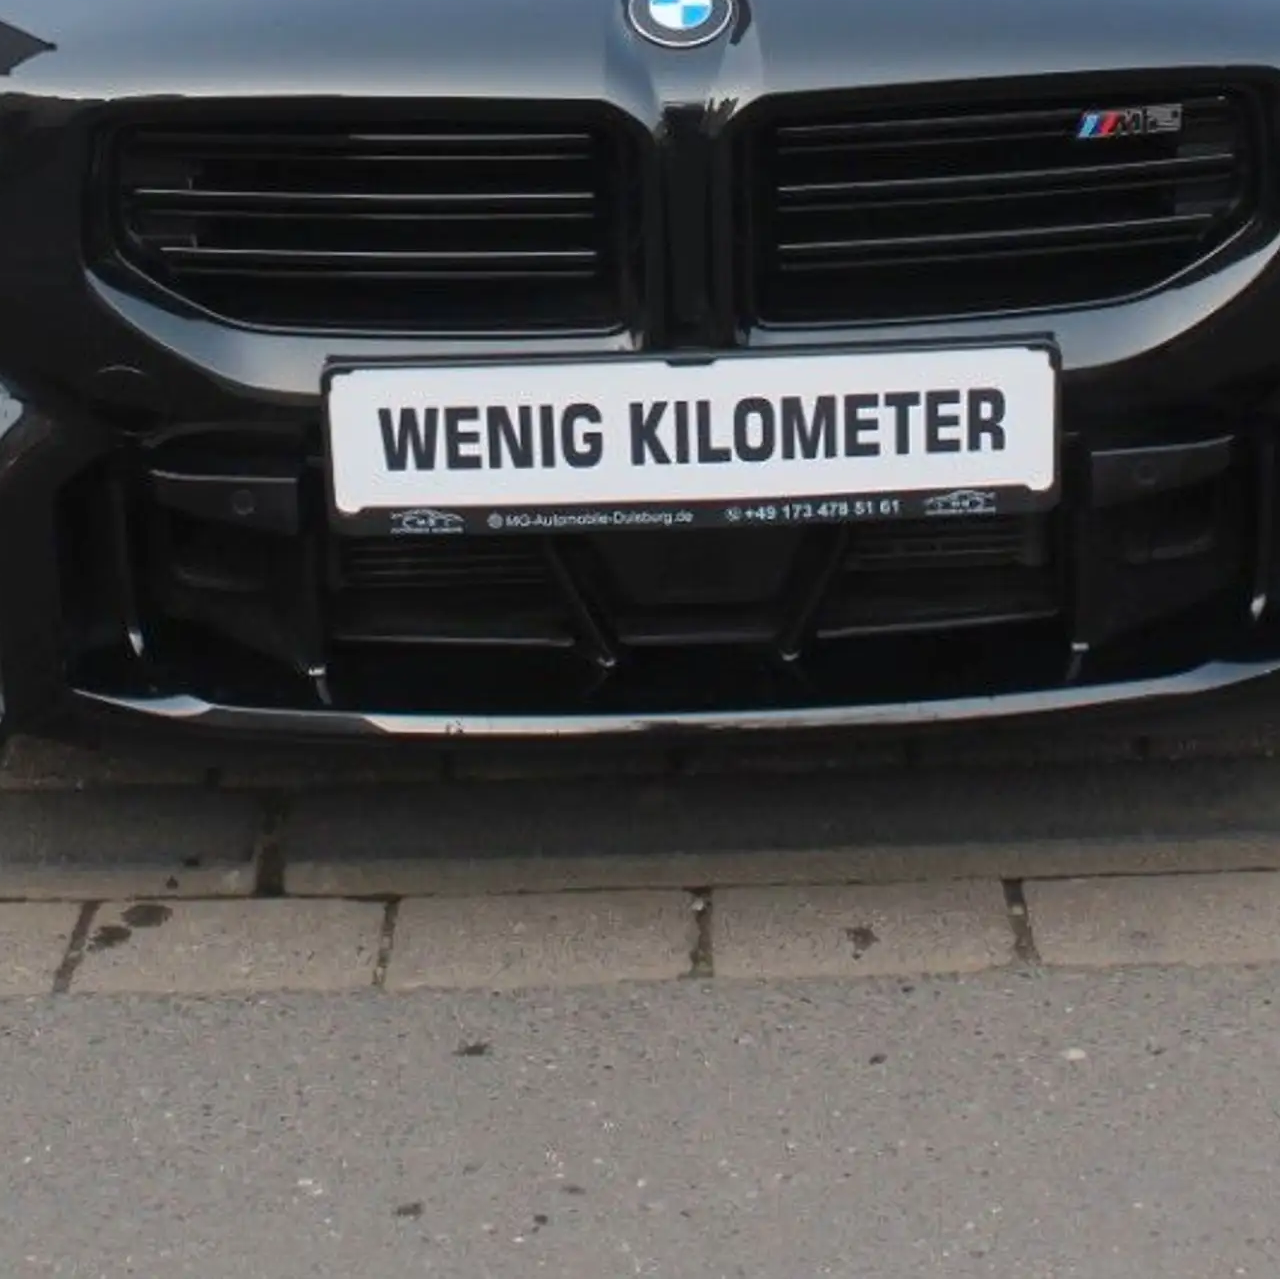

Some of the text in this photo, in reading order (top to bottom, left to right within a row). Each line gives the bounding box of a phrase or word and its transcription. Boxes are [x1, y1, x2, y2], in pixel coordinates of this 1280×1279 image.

[377, 387, 1007, 471] WENIG KILOMETER
[744, 507, 777, 521] +49
[782, 504, 812, 520] 173
